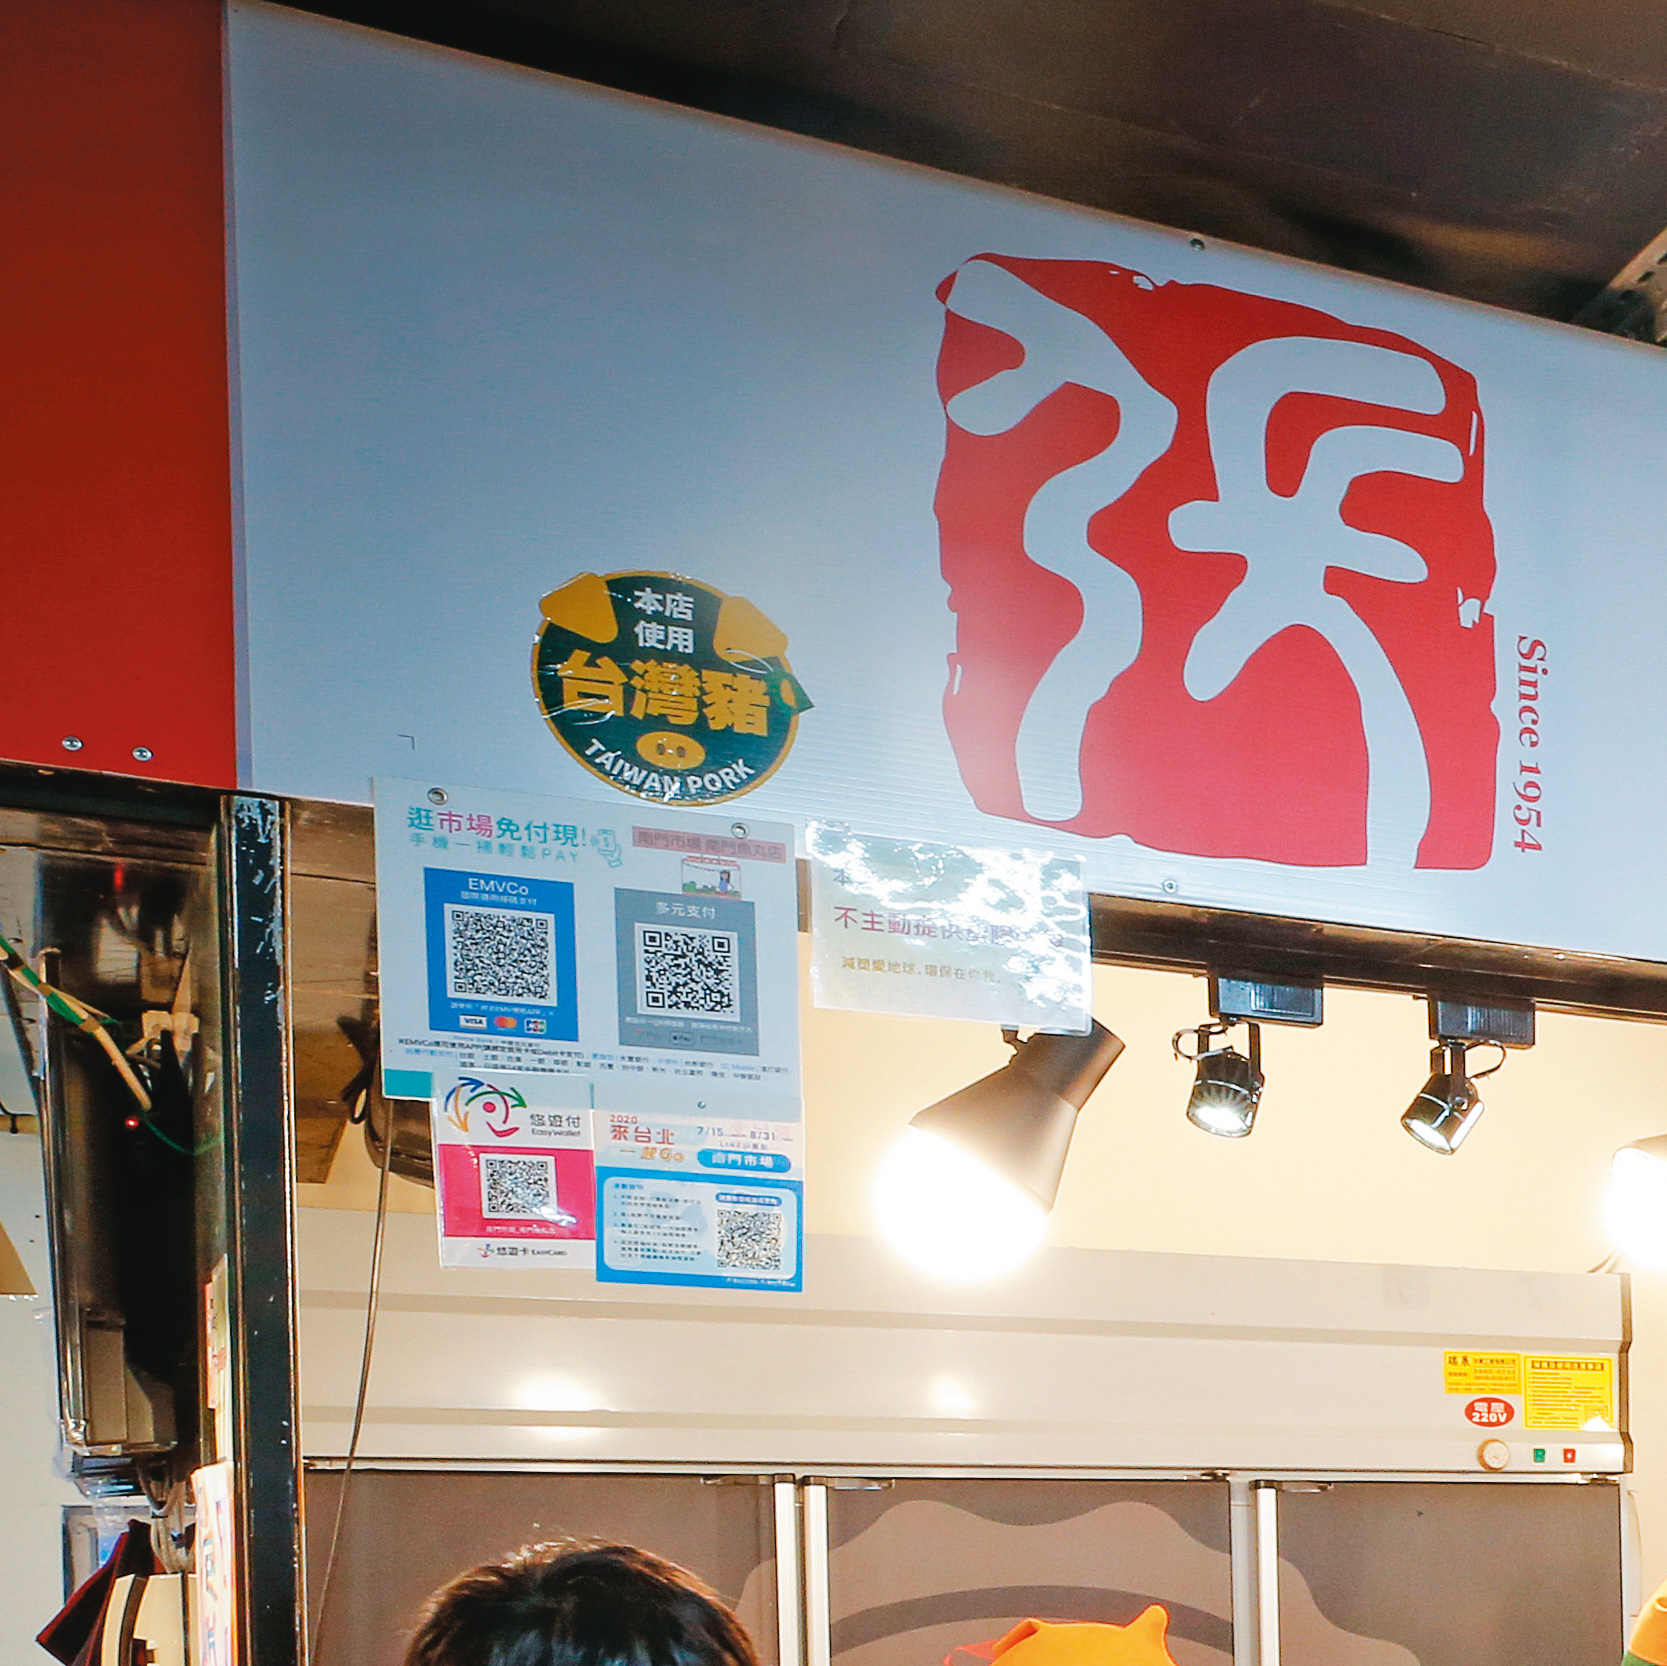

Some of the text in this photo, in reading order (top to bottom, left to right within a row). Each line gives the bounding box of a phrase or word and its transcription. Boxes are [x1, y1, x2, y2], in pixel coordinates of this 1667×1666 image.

[633, 587, 695, 621] 本店
[633, 620, 695, 654] 使用
[557, 649, 772, 737] 台灣豬
[1511, 634, 1548, 854] Since 1954
[584, 737, 756, 796] TAIWAN PORK
[407, 806, 587, 848] 逛市場免付現!
[468, 877, 529, 896] EMVCo
[655, 900, 717, 920] 多元支付
[530, 1113, 581, 1129] 悠遊付
[609, 1113, 638, 1125] 2020
[531, 1128, 582, 1138] EasyWallet
[610, 1124, 675, 1146] 來台北
[696, 1126, 776, 1141] 7/15 8/31
[620, 1145, 686, 1163] 一起Go
[711, 1151, 775, 1169] 南門市場
[496, 1246, 529, 1257] 悠遊卡
[1471, 1412, 1508, 1423] 220V
